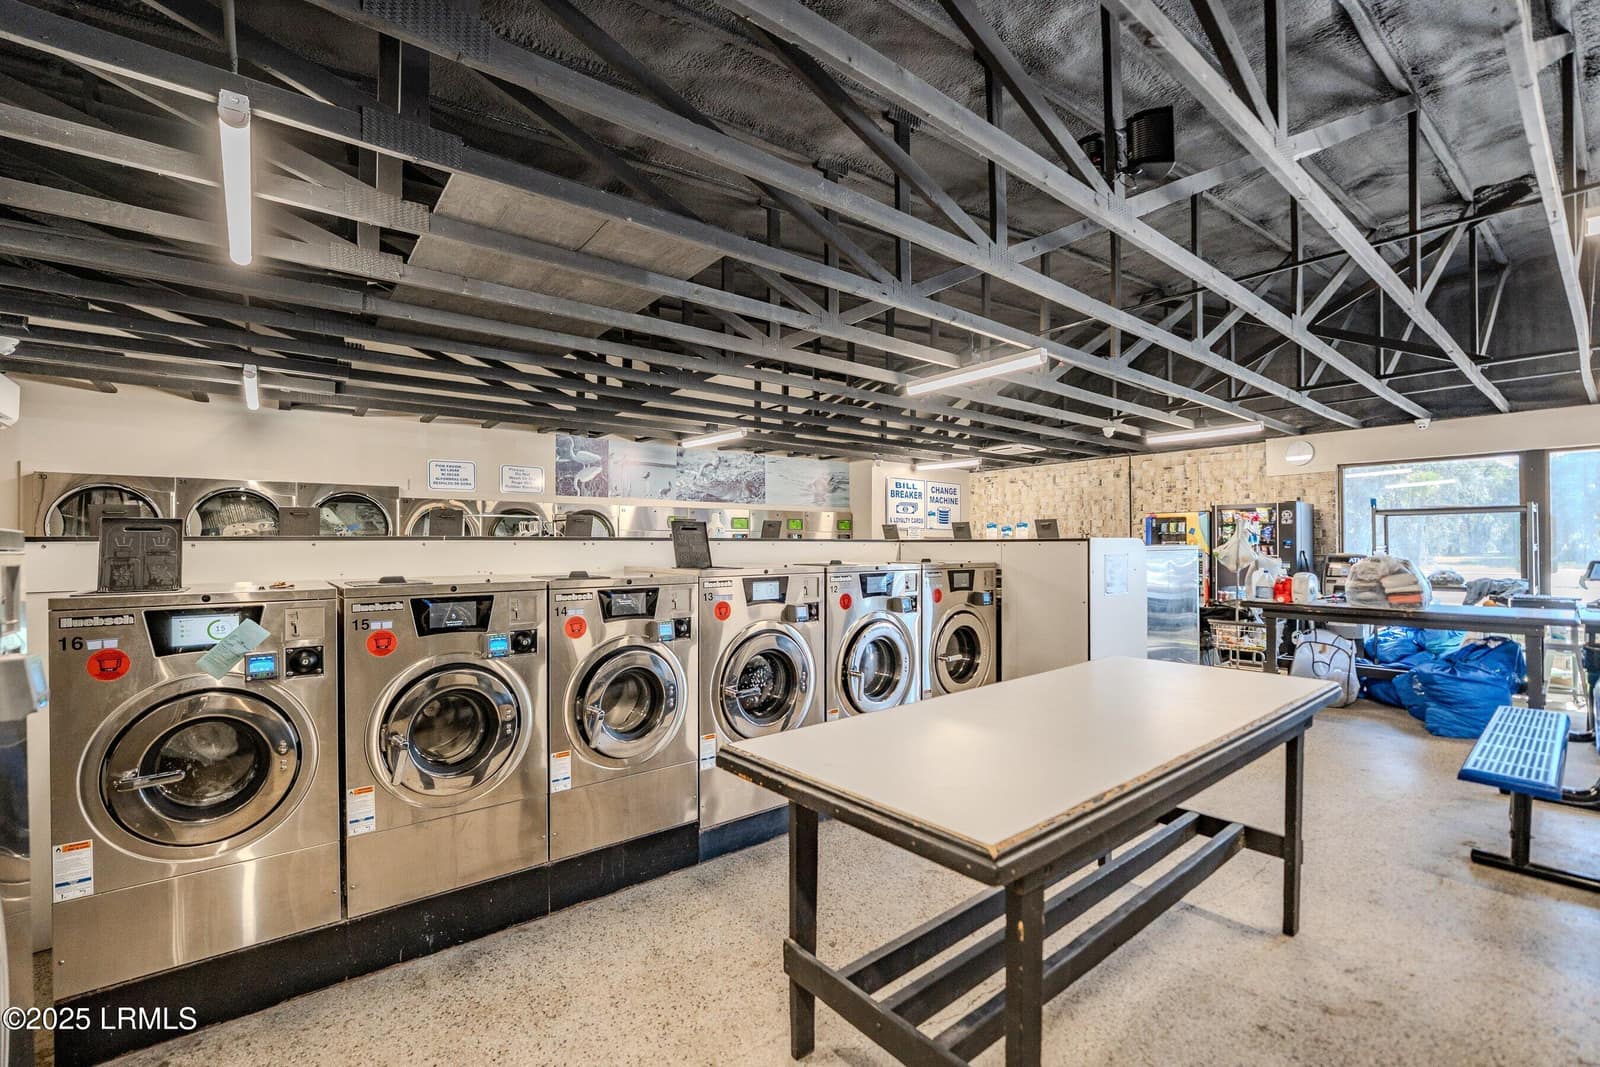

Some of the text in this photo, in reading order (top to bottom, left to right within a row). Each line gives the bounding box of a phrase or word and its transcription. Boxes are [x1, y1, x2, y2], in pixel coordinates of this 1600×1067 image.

[895, 481, 918, 490] BILL
[890, 489, 923, 500] BREAKER
[930, 486, 958, 496] CHANGE
[929, 496, 959, 505] MACHINE
[830, 585, 840, 593] 12
[703, 592, 714, 601] 13
[554, 606, 567, 616] 14
[59, 615, 134, 628] Huebsch
[351, 619, 370, 631] 15
[58, 636, 84, 651] 16
